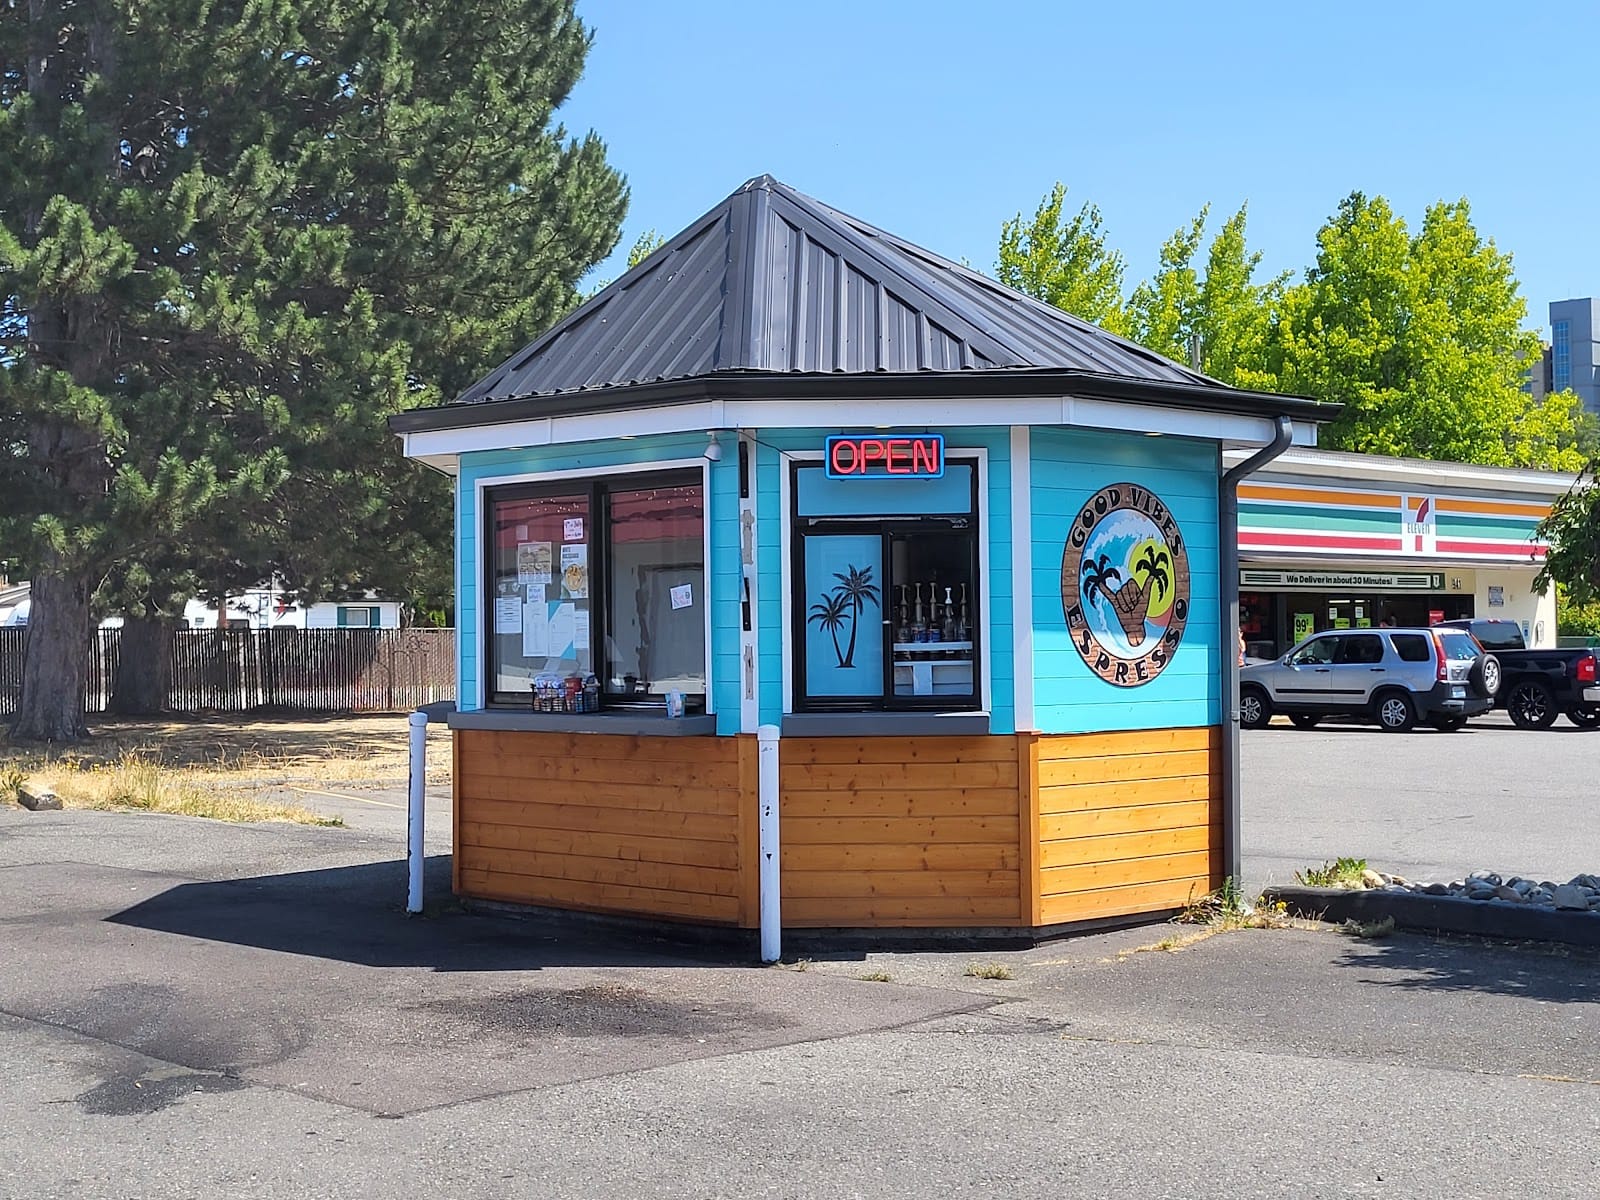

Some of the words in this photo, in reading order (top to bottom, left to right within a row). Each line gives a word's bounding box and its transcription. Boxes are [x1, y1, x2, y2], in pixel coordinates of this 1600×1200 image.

[832, 439, 938, 474] OPEN
[1070, 488, 1121, 549] GOOD
[1130, 486, 1183, 557] VIBES
[1415, 498, 1430, 553] 7
[1286, 575, 1298, 583] We
[1299, 575, 1325, 584] Deliver
[1332, 576, 1352, 585] about
[1352, 576, 1362, 585] 30
[1362, 576, 1393, 585] Minutes!
[1066, 597, 1188, 684] ESPRESSO
